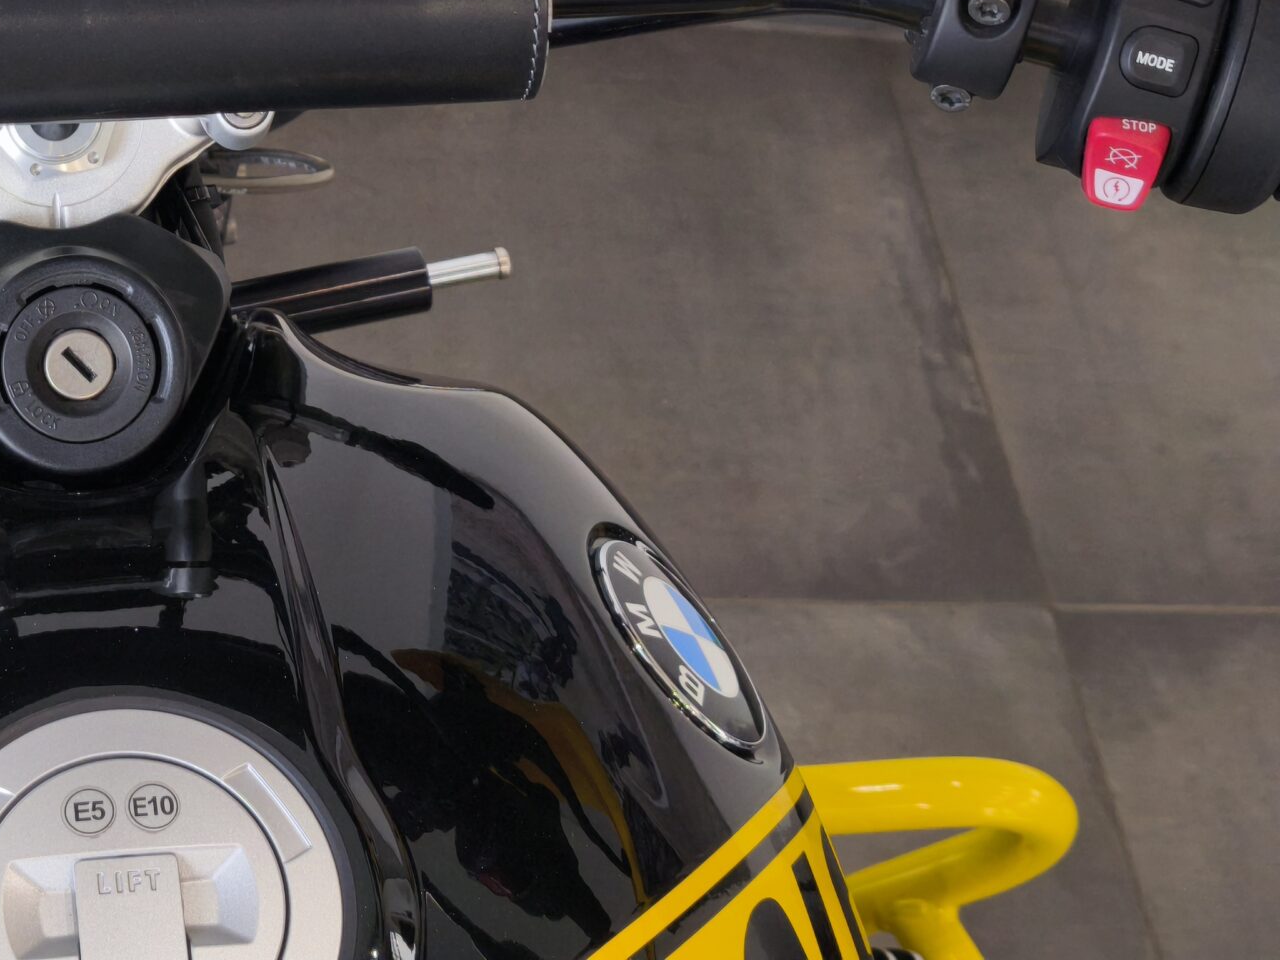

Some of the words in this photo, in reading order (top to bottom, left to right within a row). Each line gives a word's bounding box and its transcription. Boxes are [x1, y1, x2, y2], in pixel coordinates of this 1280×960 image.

[1136, 50, 1175, 73] MODE
[1122, 118, 1157, 134] STOP
[612, 550, 706, 708] BMW
[72, 800, 107, 822] E5
[132, 794, 176, 818] E10
[96, 867, 161, 895] LIFT
